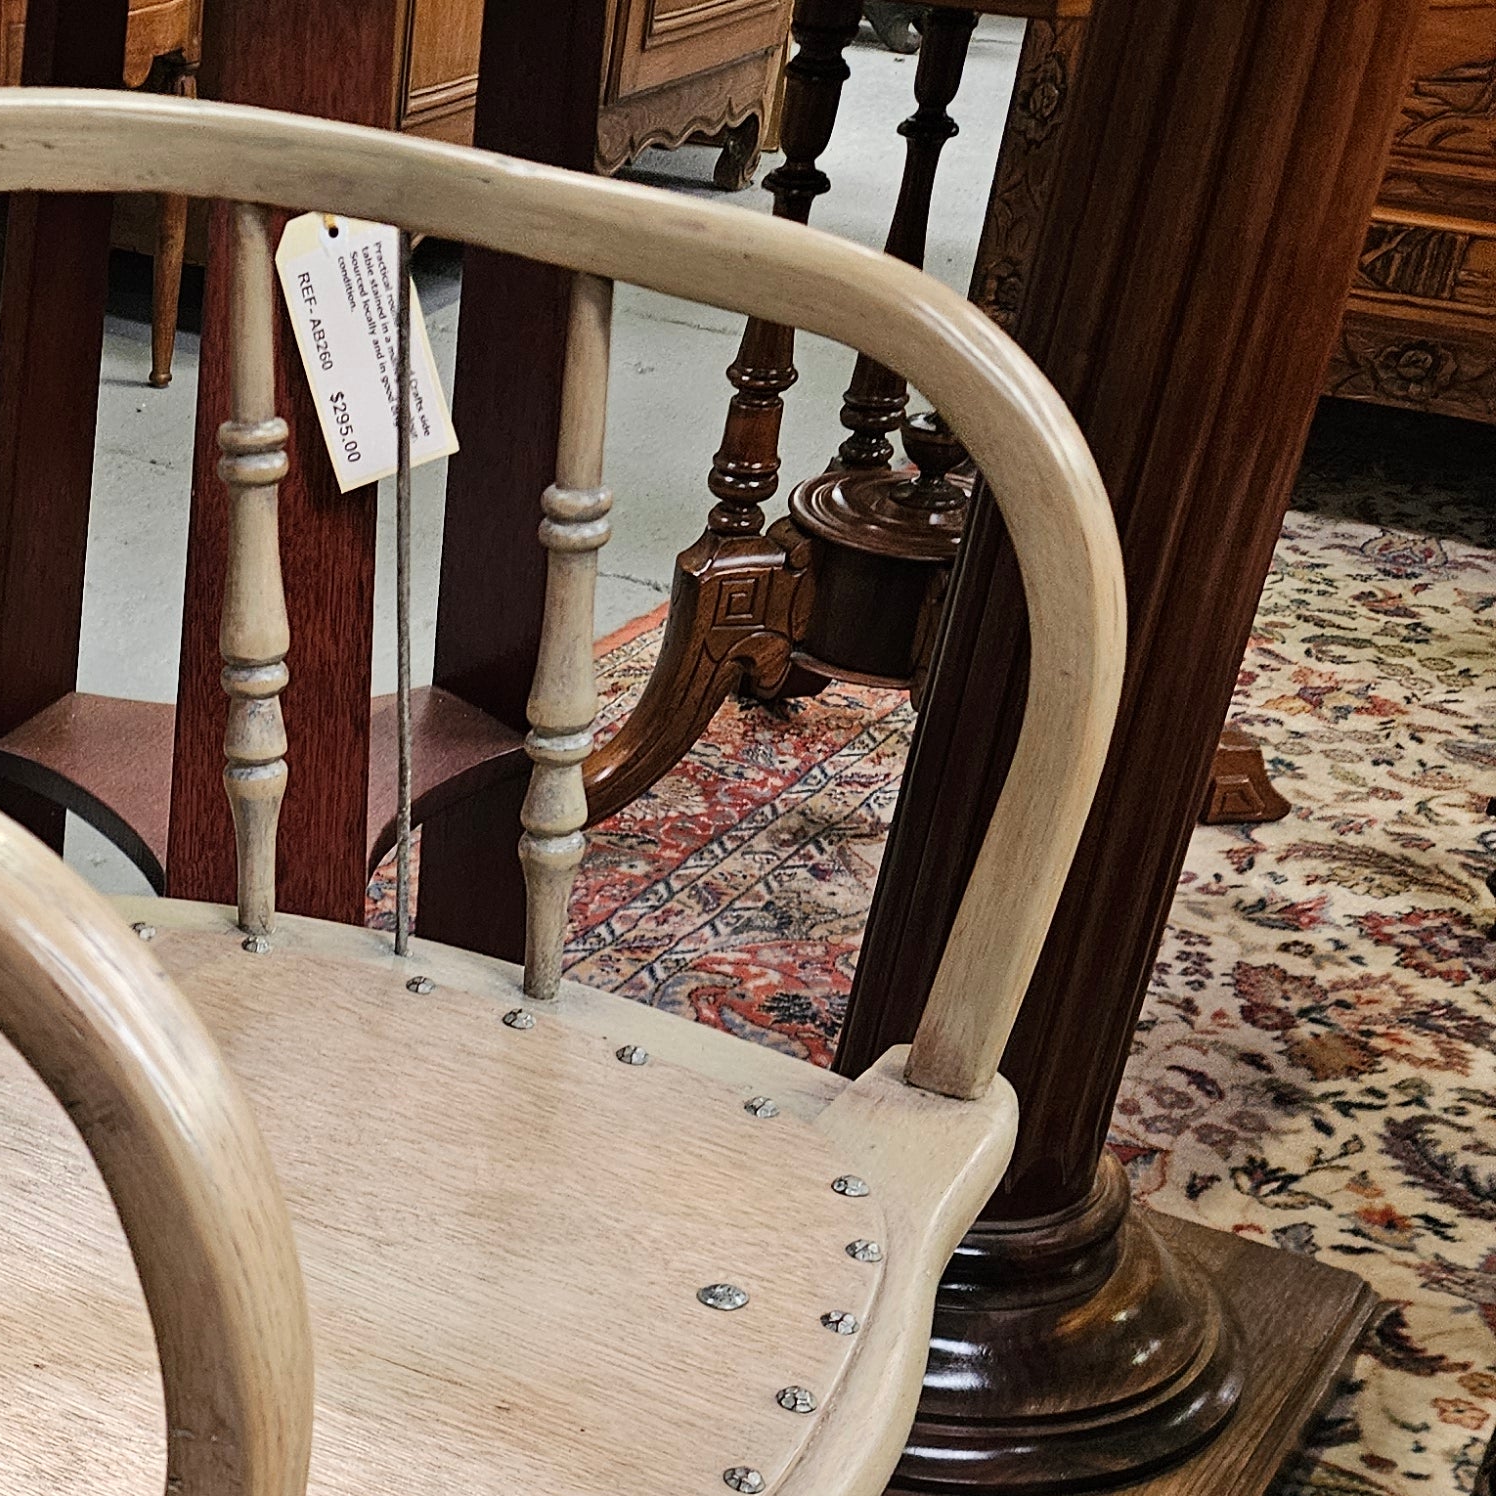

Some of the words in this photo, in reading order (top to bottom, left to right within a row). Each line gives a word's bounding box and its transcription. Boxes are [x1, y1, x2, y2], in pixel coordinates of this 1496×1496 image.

[338, 255, 357, 313] condition.
[350, 250, 368, 297] Sourced
[362, 245, 374, 276] table
[371, 278, 387, 320] stained
[382, 321, 388, 334] in
[385, 335, 391, 343] a
[363, 298, 379, 336] locally
[374, 240, 393, 291] Practical
[421, 414, 431, 436] side
[297, 271, 317, 313] REF-
[309, 320, 334, 371] AB260
[329, 390, 362, 464] $295.00
[372, 338, 384, 359] and
[380, 361, 386, 373] in
[381, 375, 398, 403] good
